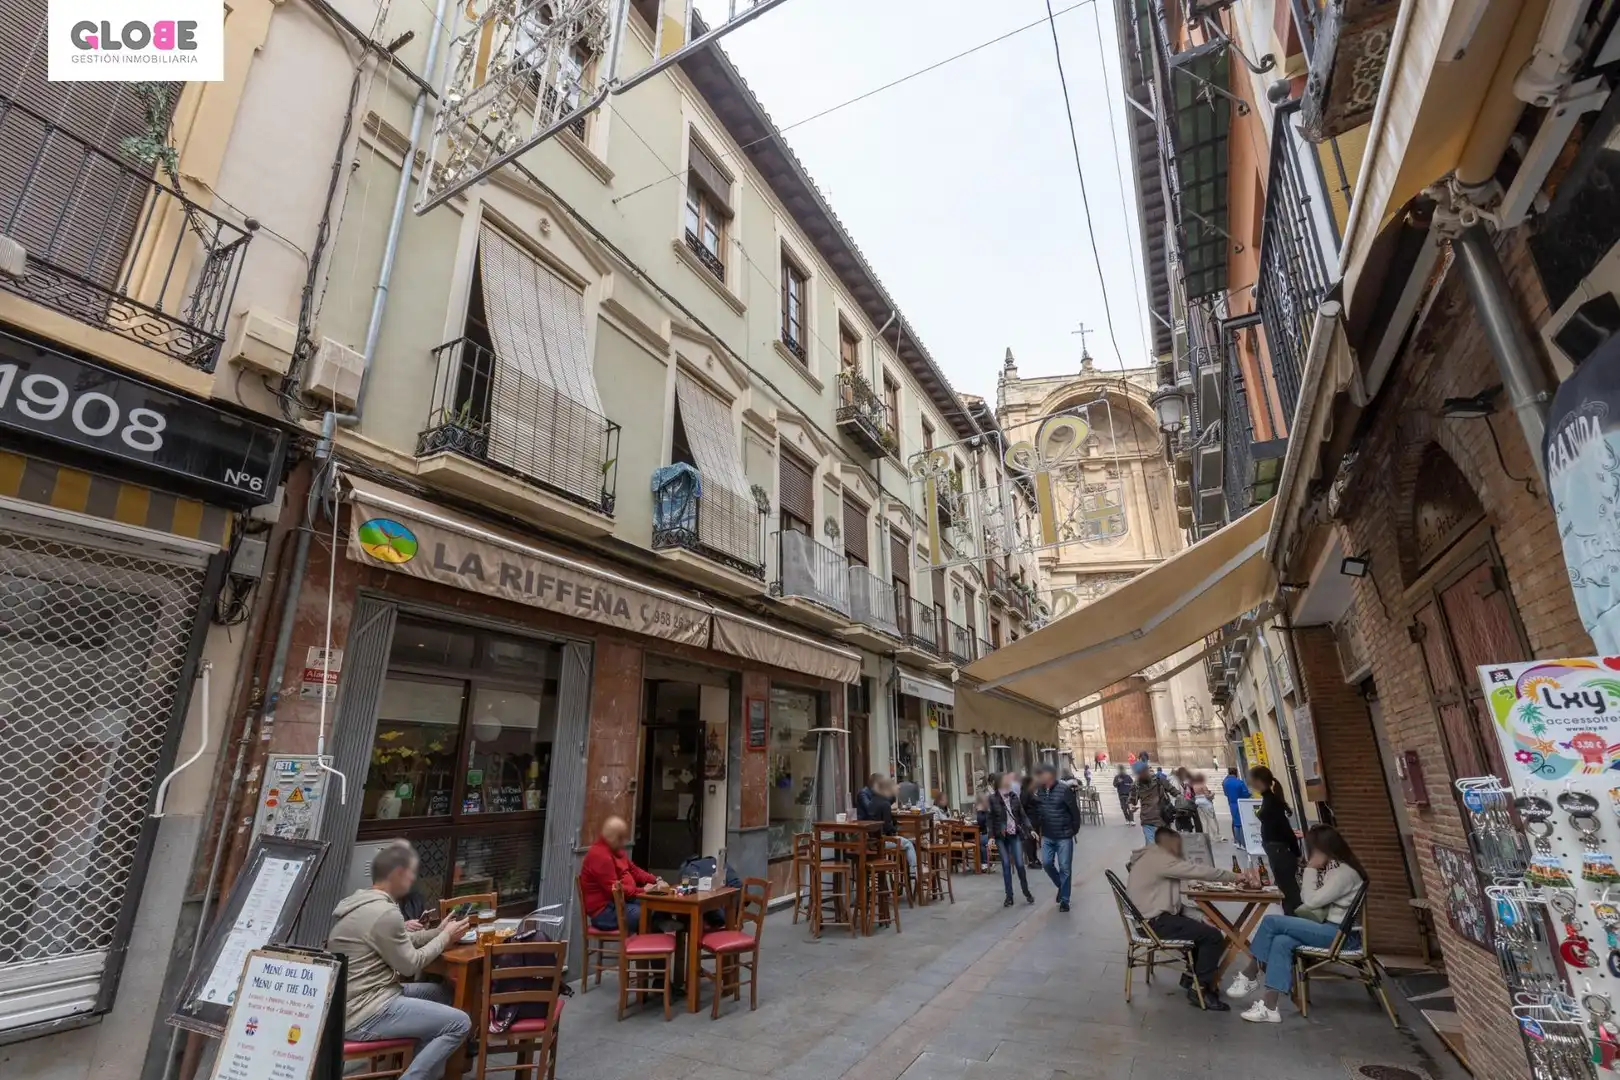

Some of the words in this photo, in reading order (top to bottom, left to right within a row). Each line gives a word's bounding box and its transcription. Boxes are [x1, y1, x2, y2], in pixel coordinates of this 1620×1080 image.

[0, 364, 167, 452] 1908
[433, 543, 485, 582] LA
[499, 564, 631, 620] RIFFEÑA
